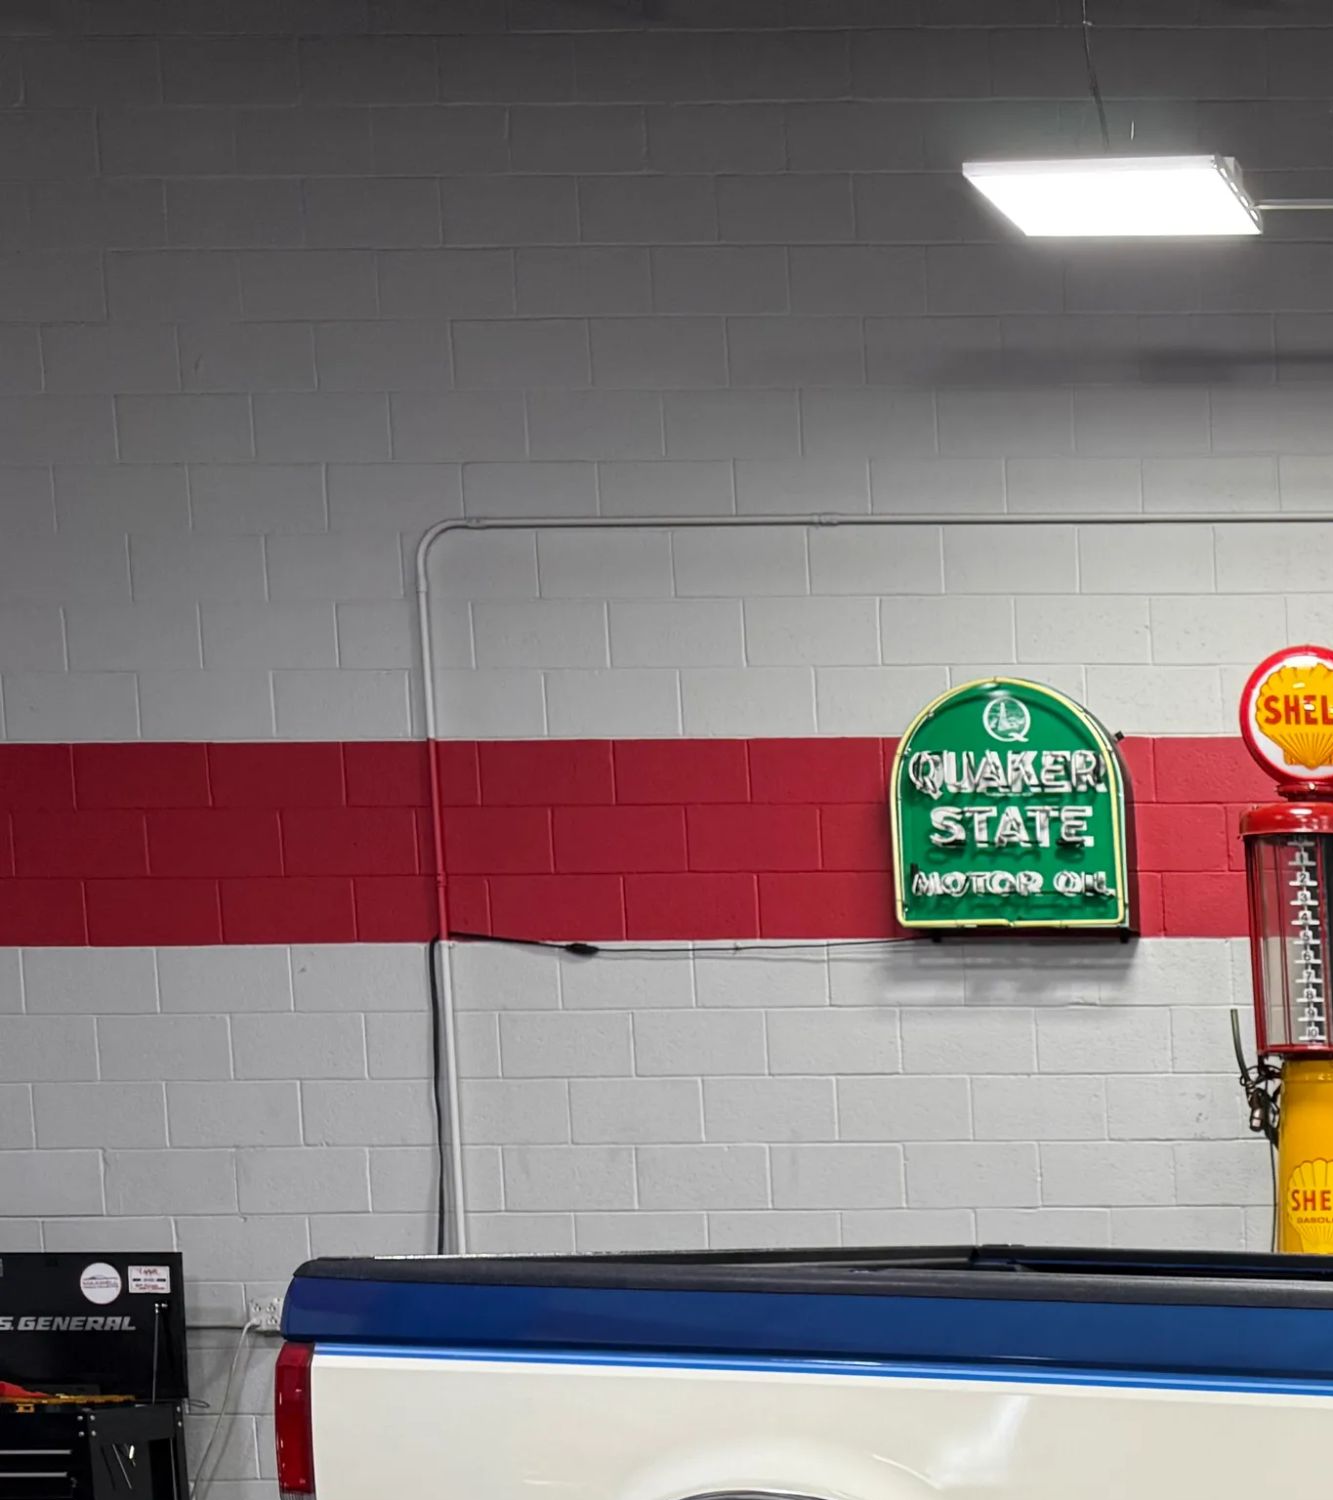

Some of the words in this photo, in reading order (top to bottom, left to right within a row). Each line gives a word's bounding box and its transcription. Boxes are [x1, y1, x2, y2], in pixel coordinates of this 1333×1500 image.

[908, 749, 1108, 800] QUAKER
[929, 805, 1095, 848] STATE
[911, 871, 1045, 897] MOTOR
[1052, 871, 1117, 897] OIL
